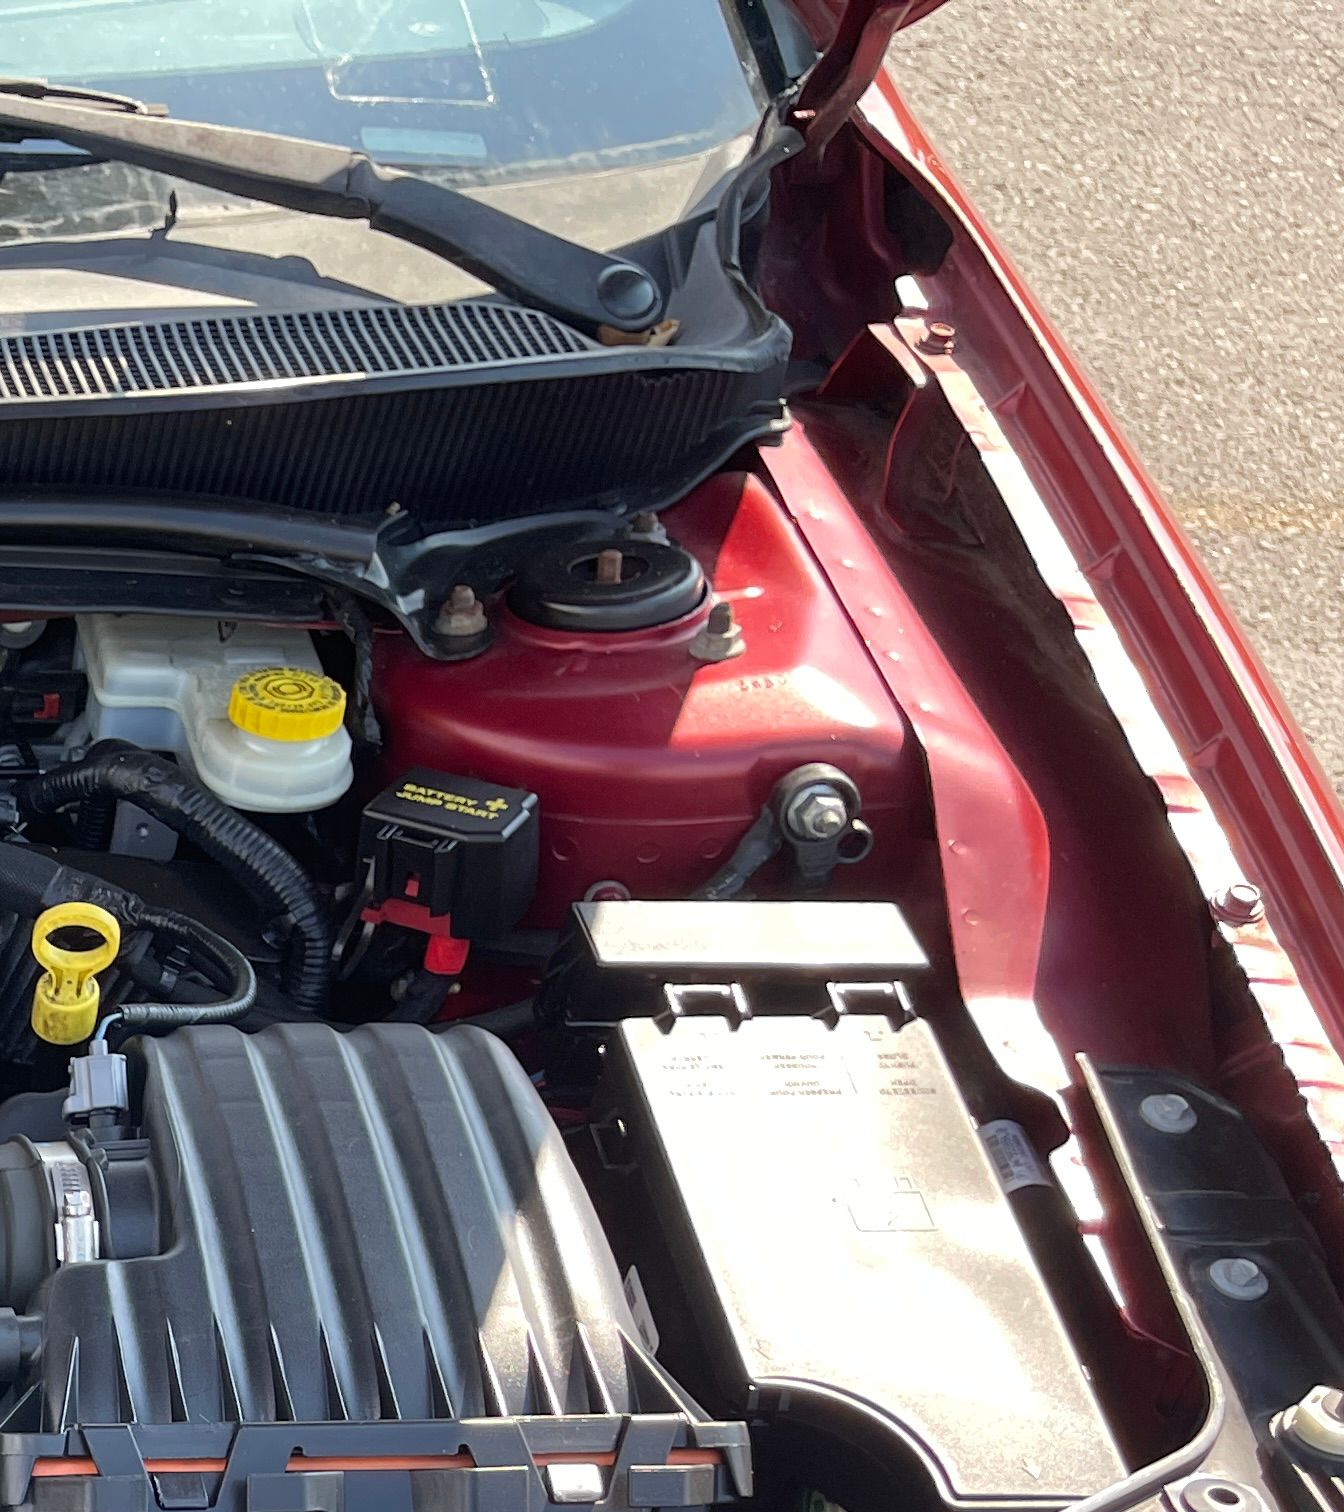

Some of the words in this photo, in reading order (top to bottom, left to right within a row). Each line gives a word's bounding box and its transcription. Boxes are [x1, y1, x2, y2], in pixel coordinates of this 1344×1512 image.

[395, 791, 443, 806] JUMP
[444, 802, 499, 819] START
[403, 783, 479, 806] BATTERY
